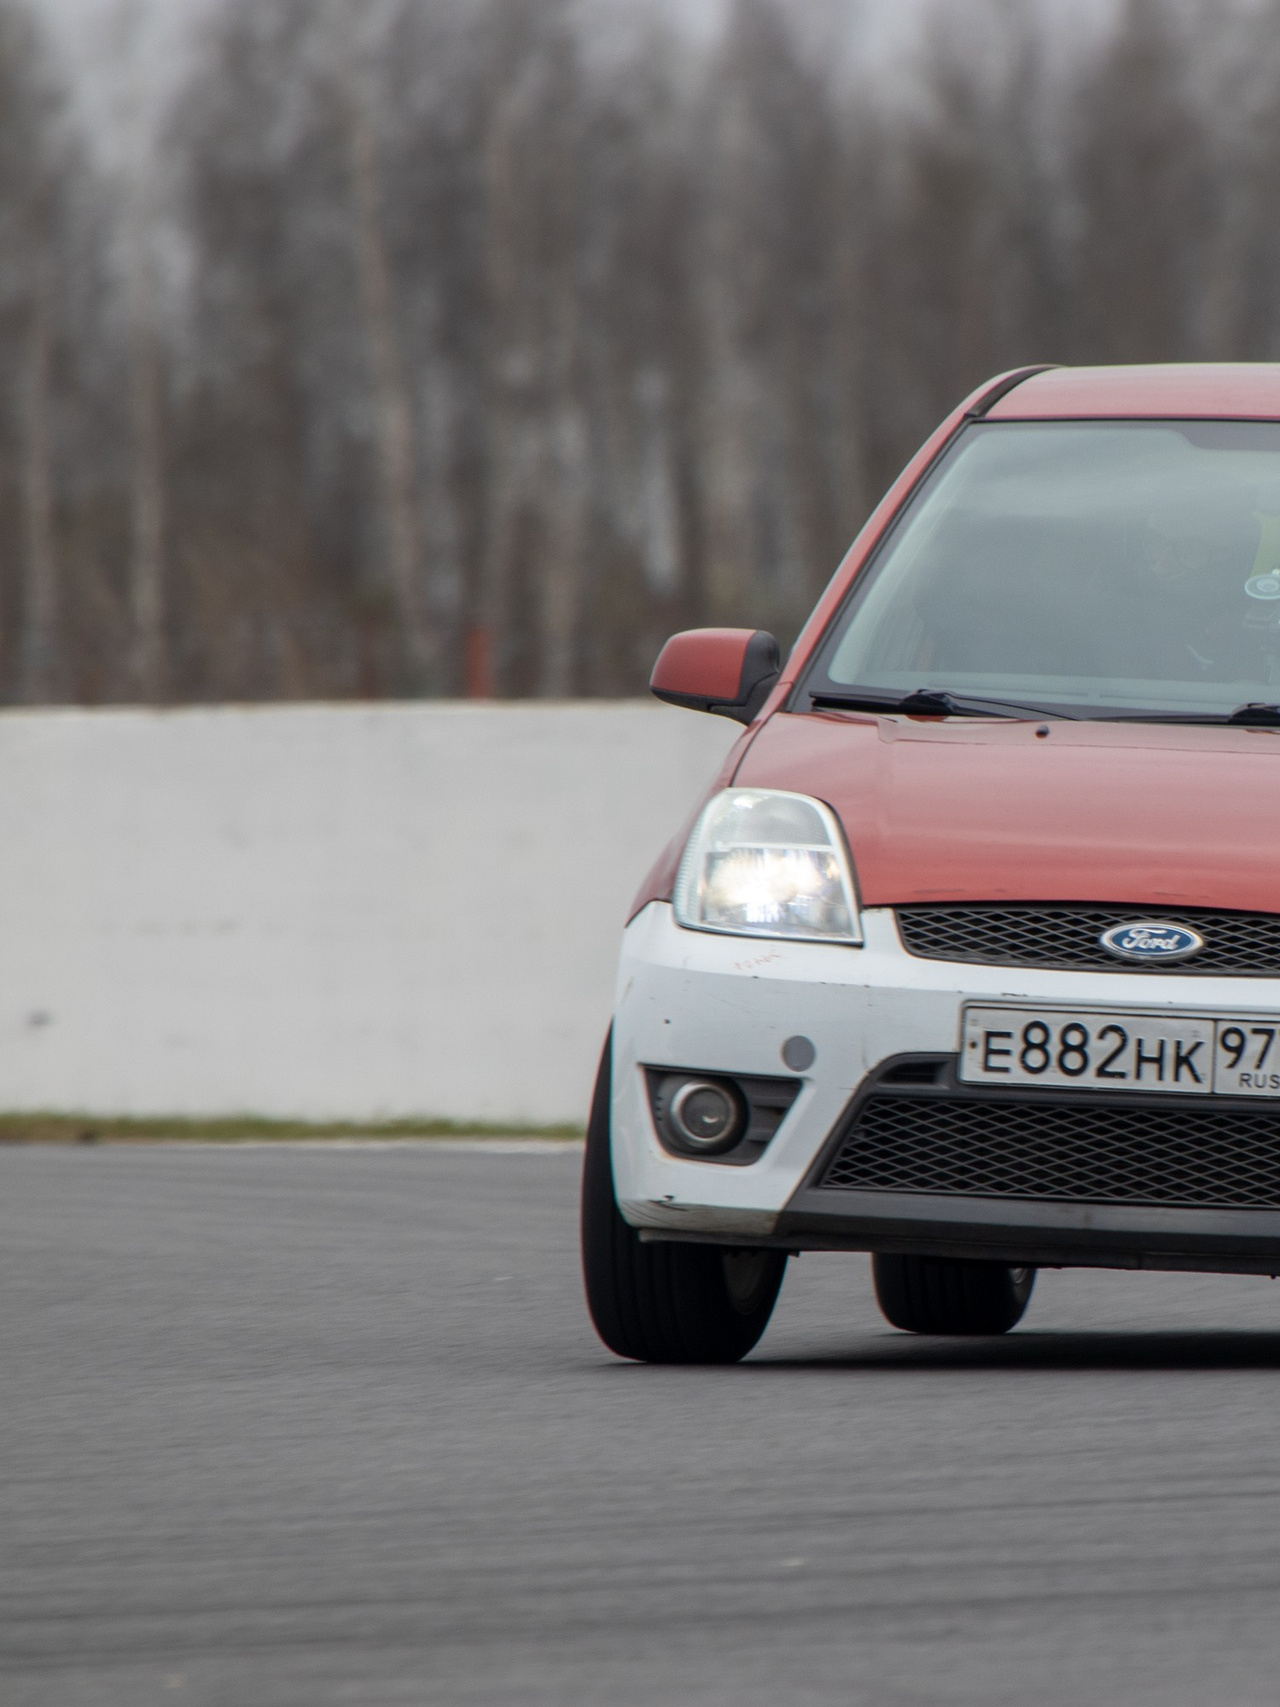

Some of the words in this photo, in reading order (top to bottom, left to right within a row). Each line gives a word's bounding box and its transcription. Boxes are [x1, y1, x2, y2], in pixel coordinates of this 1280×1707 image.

[1122, 928, 1181, 950] Ford
[981, 1020, 1206, 1084] E882HK
[1238, 1072, 1280, 1090] RUS
